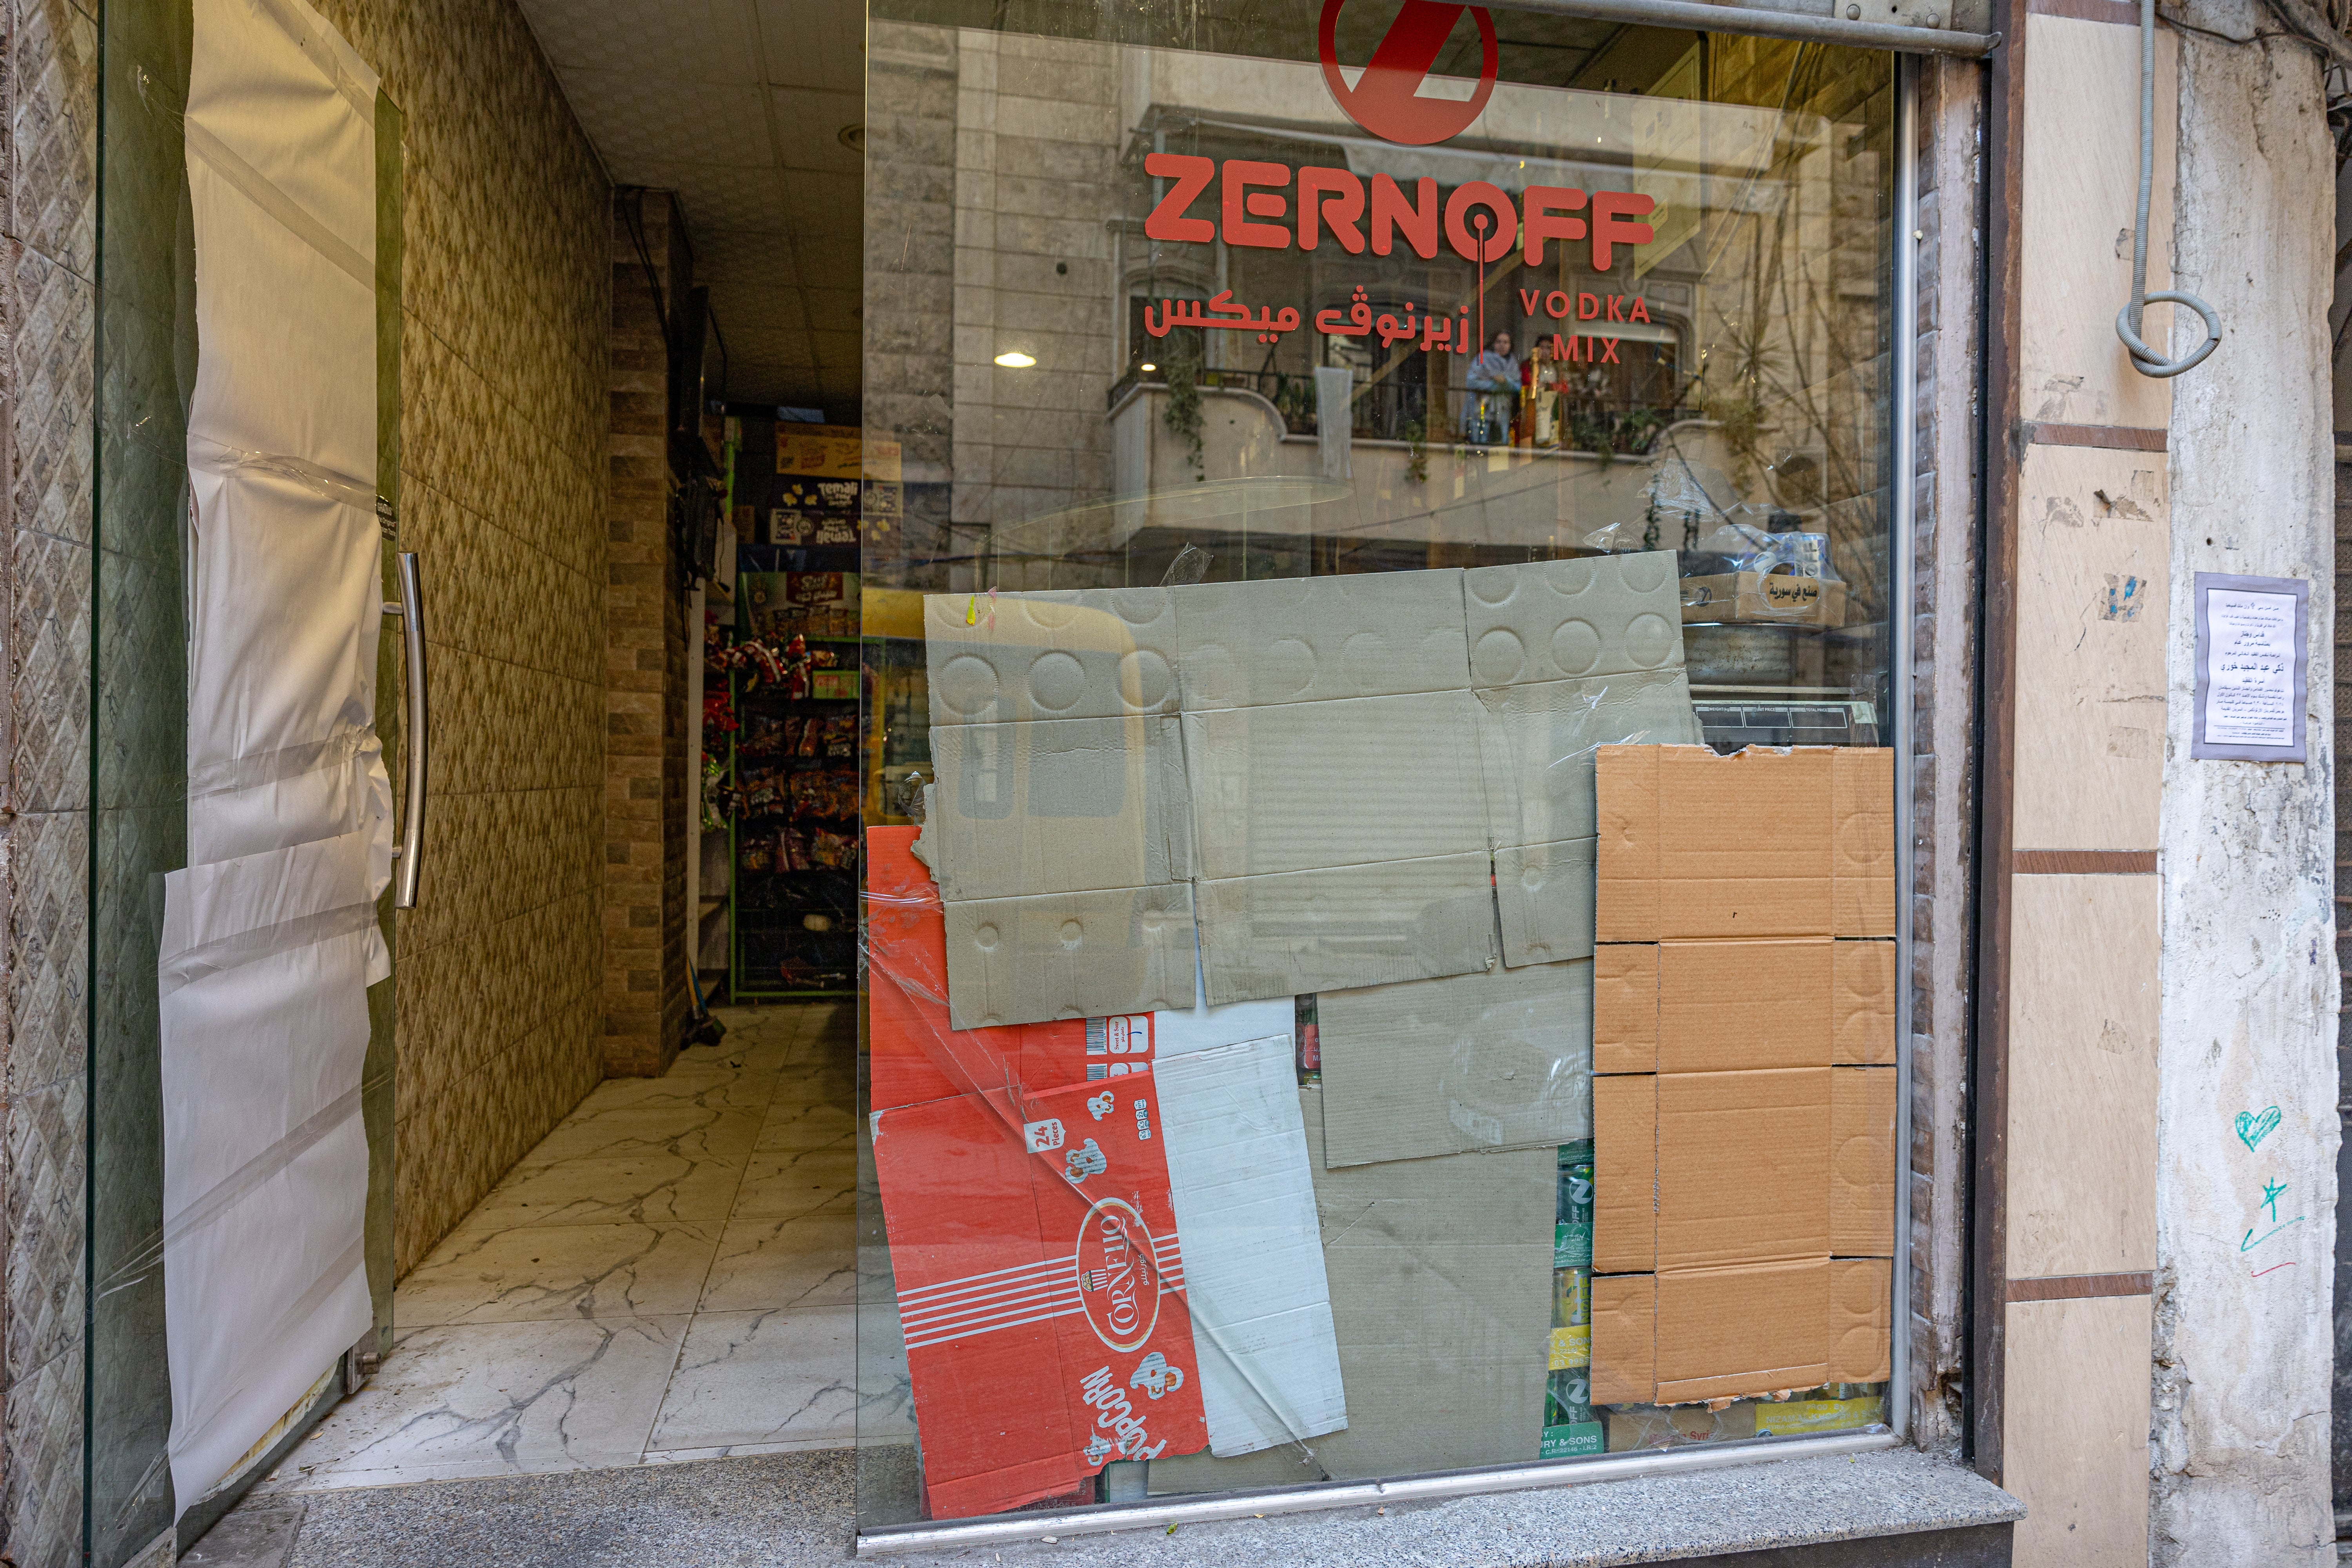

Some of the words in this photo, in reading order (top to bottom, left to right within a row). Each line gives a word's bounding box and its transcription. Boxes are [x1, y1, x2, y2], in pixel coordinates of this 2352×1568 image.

[1145, 153, 1655, 271] ZERNOFF
[1145, 289, 1300, 343] ميكس
[1520, 289, 1651, 323] VODKA
[1553, 334, 1620, 364] MIX
[1769, 582, 1791, 600] سورية
[1792, 583, 1800, 602] في
[1802, 586, 1817, 601] صنع
[1034, 1125, 1050, 1148] 24
[1080, 1365, 1167, 1461] POPCORN
[1569, 1435, 1597, 1445] SONS
